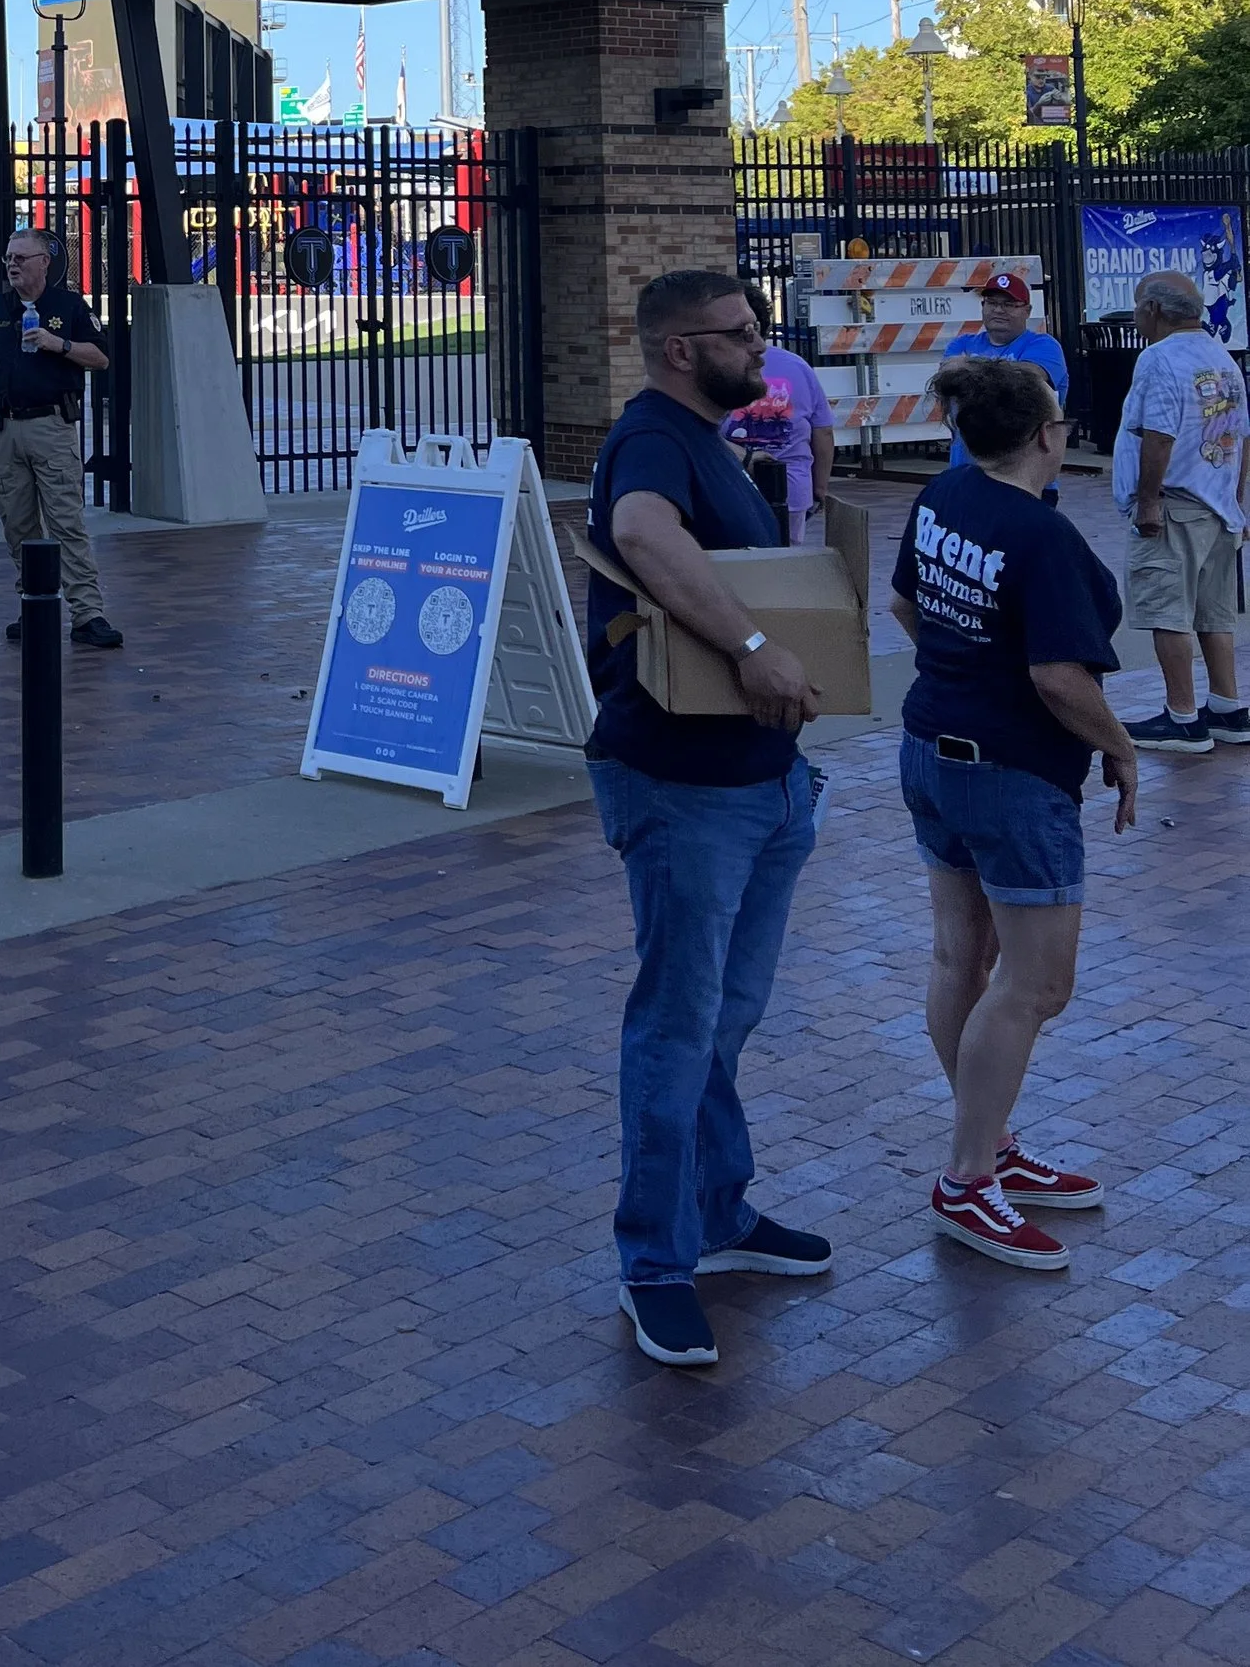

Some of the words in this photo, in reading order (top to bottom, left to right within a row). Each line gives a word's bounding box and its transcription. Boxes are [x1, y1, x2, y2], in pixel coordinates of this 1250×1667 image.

[1086, 247, 1145, 275] GRAND
[1148, 247, 1197, 274] SLAM
[910, 297, 952, 316] DRILLERS
[402, 507, 448, 532] Drillers
[352, 543, 371, 553] SKIP
[373, 545, 389, 555] THE
[391, 547, 411, 557] LINE
[915, 505, 1005, 592] Brent
[357, 558, 374, 567] BUY
[375, 560, 407, 570] ONLINE!
[434, 551, 462, 563] LOGIN
[464, 555, 478, 565] TO
[420, 564, 443, 575] YOUR
[445, 567, 488, 579] ACCOUNT
[368, 668, 429, 686] DIRECTIONS
[360, 683, 380, 693] OPEN
[381, 686, 407, 697] PHONE
[407, 690, 439, 702] CAMERA
[377, 696, 396, 707] SCAN
[397, 699, 418, 711] CODE
[359, 704, 384, 715] TOUCH
[385, 708, 415, 721] BANNER
[415, 712, 434, 724] LINK
